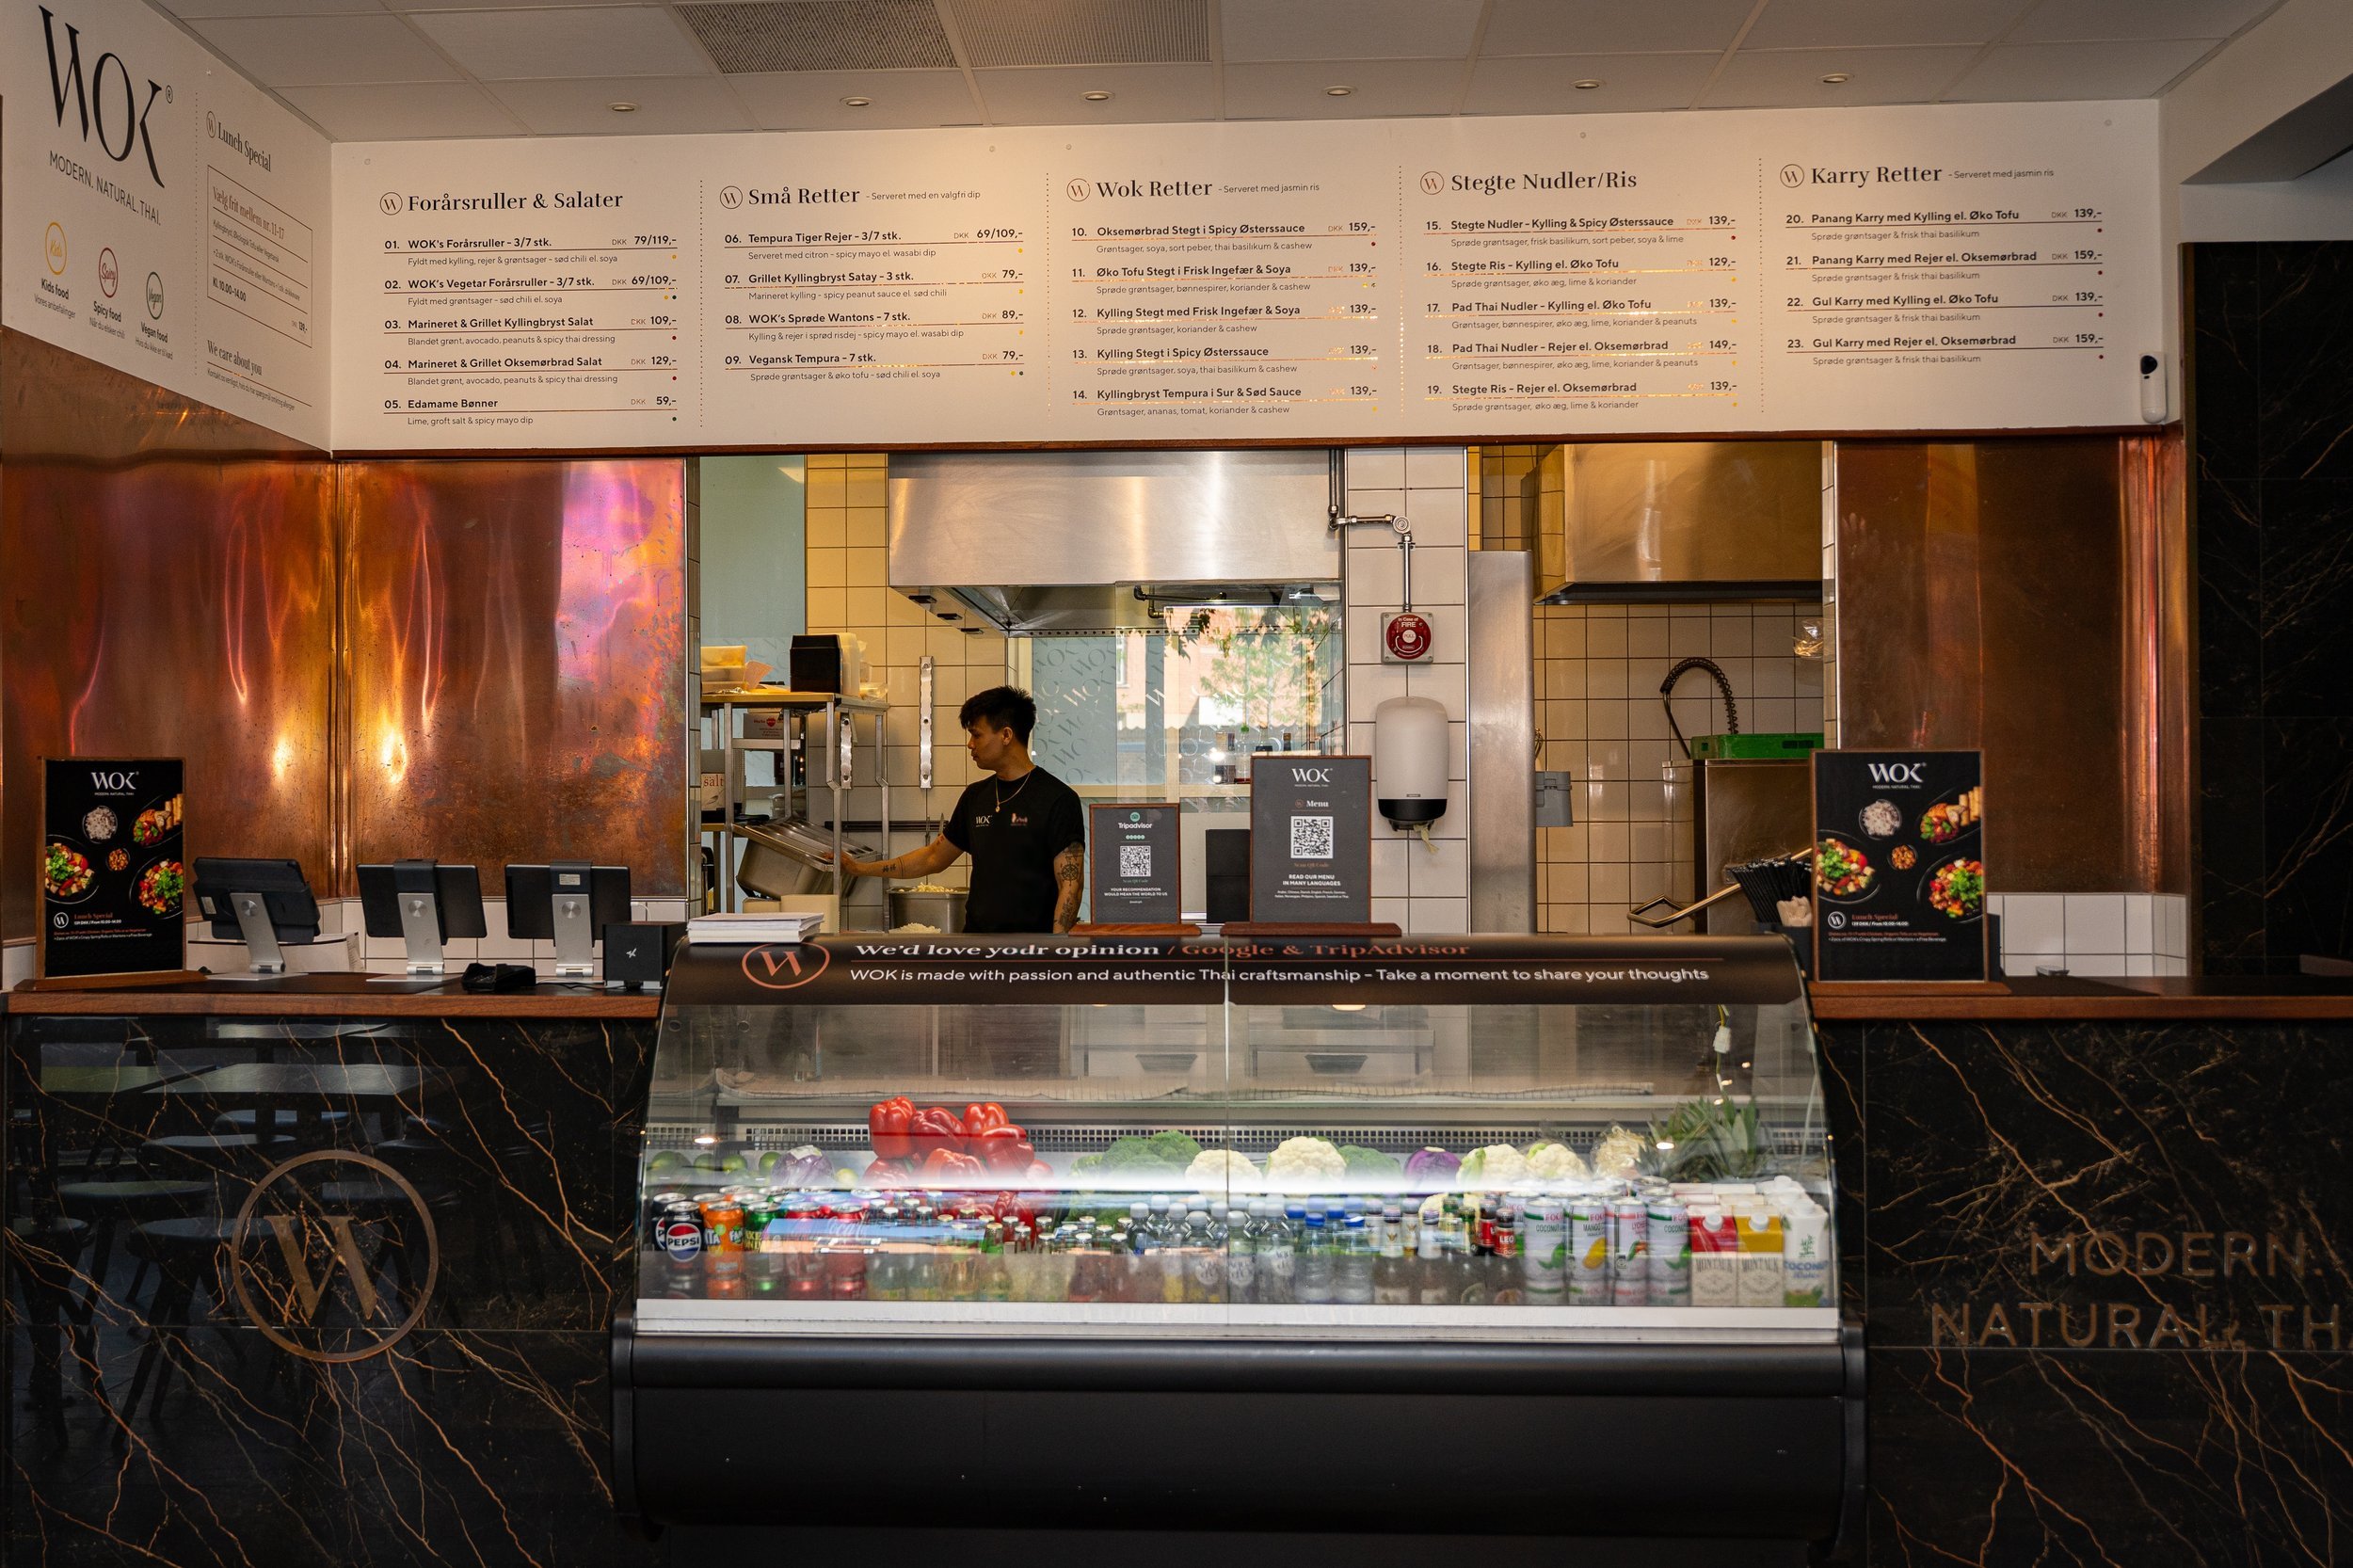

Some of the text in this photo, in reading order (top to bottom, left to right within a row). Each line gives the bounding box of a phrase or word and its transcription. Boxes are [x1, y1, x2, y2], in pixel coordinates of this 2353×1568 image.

[218, 122, 271, 172] Lunch Special
[1451, 169, 1637, 197] Stegte Nudler/Ris
[1811, 165, 1943, 189] Karry Retter
[50, 151, 161, 226] MODERN. NATURAL. THAI.
[748, 186, 860, 205] Små Retter
[1096, 179, 1213, 198] Wok Retter
[408, 190, 623, 212] Forårsruller & Salater
[1785, 214, 1804, 224] 20.
[1812, 213, 1852, 225] Panang
[1855, 213, 1884, 225] Karry
[1886, 212, 1911, 222] med
[1913, 211, 1951, 223] Kylling
[1954, 211, 1967, 220] el.
[1969, 210, 1993, 220] Øko
[1994, 210, 2019, 220] Tofu
[2074, 207, 2102, 219] 139,-
[1072, 227, 1087, 237] 10.
[1096, 226, 1169, 236] Oksemørbrad
[1172, 225, 1201, 237] Stegt
[1203, 225, 1206, 234] i
[1209, 224, 1238, 236] Spicy
[1240, 223, 1305, 233] Østerssauce
[1349, 221, 1376, 232] 159,-
[1426, 262, 1442, 272] 16.
[1451, 261, 1487, 273] Stegte
[1489, 261, 1506, 270] Ris
[1515, 260, 1553, 272] Kylling
[1555, 259, 1568, 269] el.
[1570, 259, 1593, 269] Øko
[1595, 258, 1619, 268] Tofu
[1708, 256, 1737, 268] 129,-
[102, 263, 116, 288] Spicy
[725, 274, 740, 284] 07.
[748, 273, 781, 283] Grillet
[784, 272, 846, 285] Kyllingbryst
[848, 271, 877, 284] Satay
[886, 271, 893, 281] 3
[895, 271, 914, 280] stk.
[1001, 269, 1023, 280] 79,-
[41, 278, 69, 300] Kids food
[149, 288, 162, 309] Vegan
[93, 301, 109, 319] Spicy
[109, 309, 121, 322] food
[140, 322, 156, 339] Vegan
[156, 329, 168, 344] food
[207, 340, 263, 376] We care about you
[384, 399, 402, 409] 05.
[408, 399, 458, 409] Edamame
[461, 398, 499, 408] Bønner
[656, 395, 677, 407] 59,-
[408, 417, 429, 426] Lime,
[430, 416, 451, 427] groft
[467, 416, 473, 424] &
[474, 416, 495, 426] spicy
[496, 417, 520, 425] mayo
[520, 415, 534, 425] dip
[91, 772, 136, 791] WOK
[703, 775, 724, 787] salt
[1291, 768, 1331, 783] WOK
[1867, 762, 1924, 783] WOK
[856, 945, 919, 955] We'd
[927, 945, 981, 955] love
[1055, 945, 1159, 958] opinion
[1181, 945, 1273, 958] Google
[1282, 945, 1304, 955] &
[1310, 944, 1470, 958] TripAdvisor
[850, 969, 898, 981] WOK
[901, 969, 913, 981] is
[917, 969, 966, 981] made
[968, 969, 1004, 981] with
[1009, 969, 1073, 984] passion
[1077, 969, 1109, 981] and
[1112, 969, 1195, 981] authentic
[1198, 968, 1236, 981] Thai
[1239, 969, 1361, 984] craftsmanship
[1375, 968, 1417, 981] Take
[1420, 971, 1431, 981] a
[1434, 969, 1509, 981] moment
[1512, 969, 1531, 981] to
[1533, 968, 1583, 980] share
[1584, 971, 1625, 983] your
[1627, 968, 1709, 983] thoughts
[667, 1237, 700, 1246] PEPSI
[2029, 1230, 2323, 1277] MODERN.
[2259, 1303, 2353, 1350] TH
